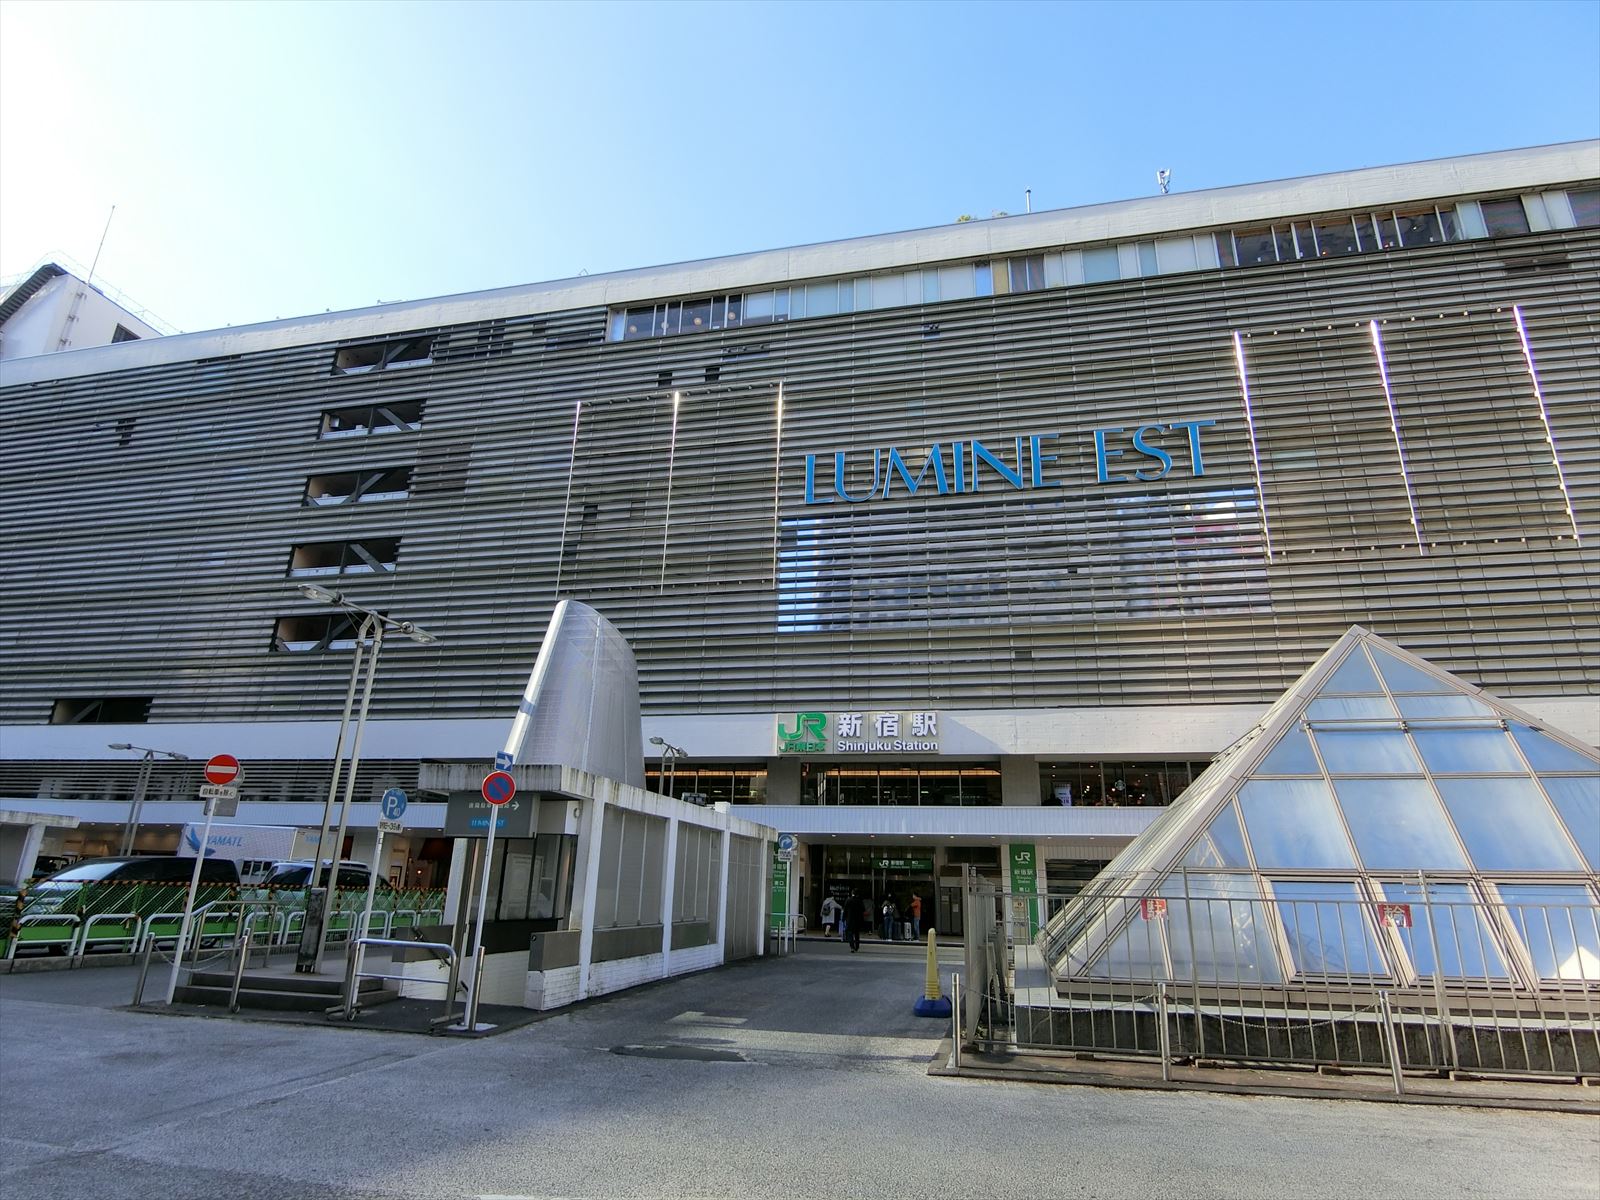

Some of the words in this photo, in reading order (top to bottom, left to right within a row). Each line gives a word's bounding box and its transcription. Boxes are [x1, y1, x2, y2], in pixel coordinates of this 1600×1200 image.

[805, 434, 1060, 504] LUMINE
[1094, 419, 1216, 483] EST
[778, 712, 828, 741] JR
[838, 712, 937, 737] 新宿駅
[838, 740, 891, 753] Shinjuku
[893, 739, 938, 751] Station
[386, 796, 398, 816] P
[1015, 852, 1031, 862] JR
